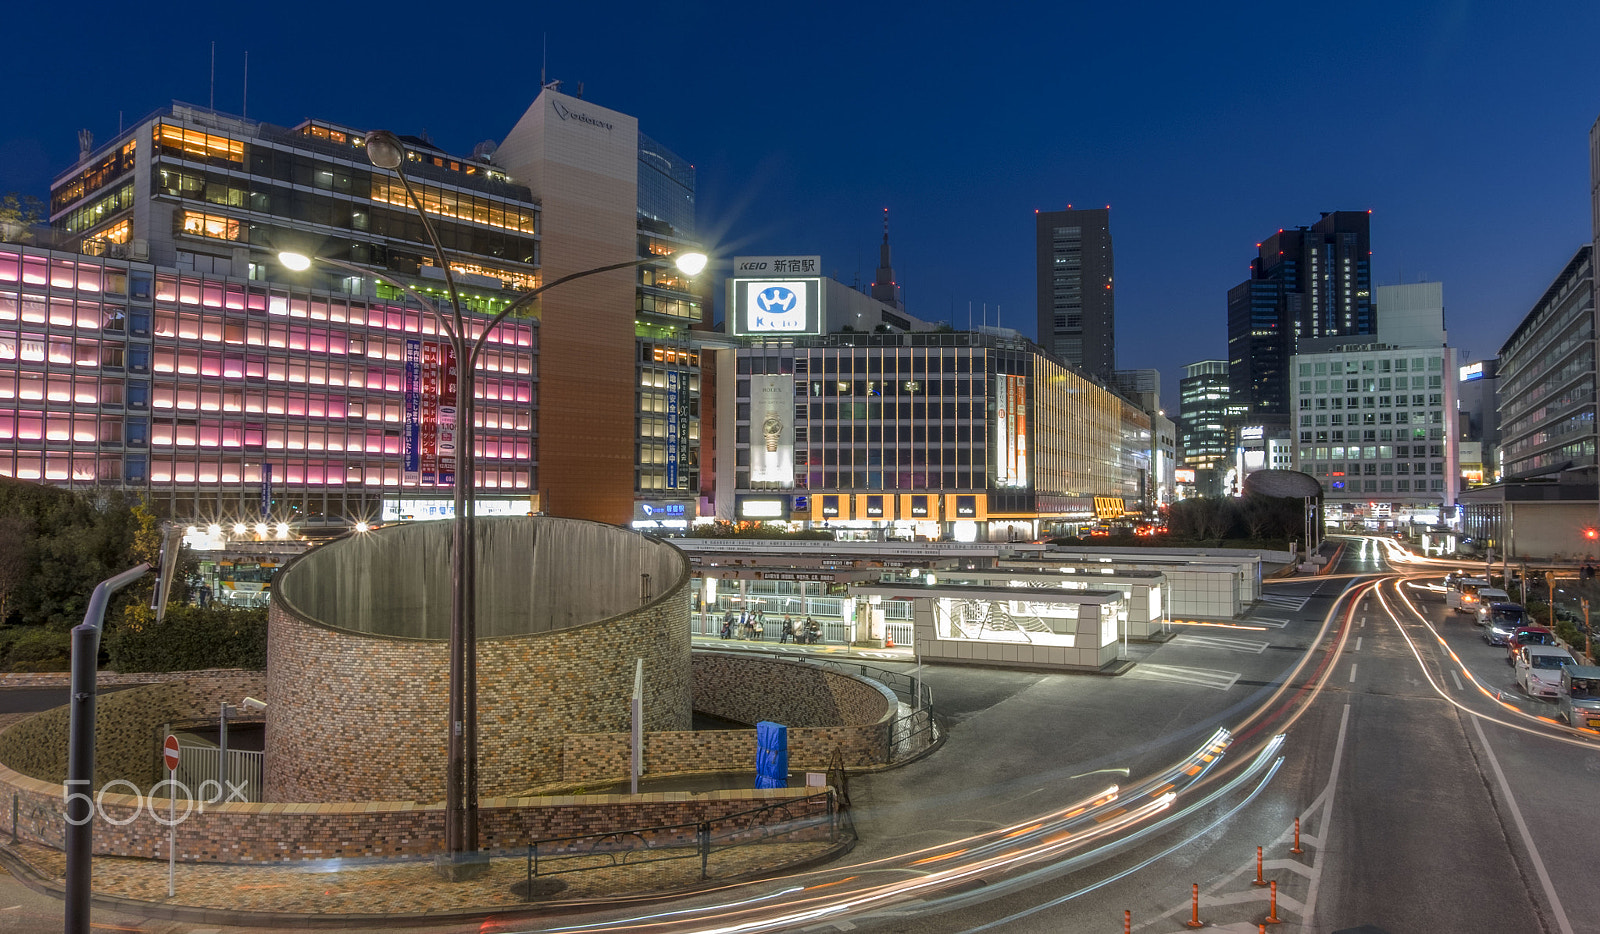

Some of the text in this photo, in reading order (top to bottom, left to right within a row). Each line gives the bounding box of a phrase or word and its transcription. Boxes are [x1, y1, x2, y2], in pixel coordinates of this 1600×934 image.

[740, 259, 815, 273] KEIO 新宿駅
